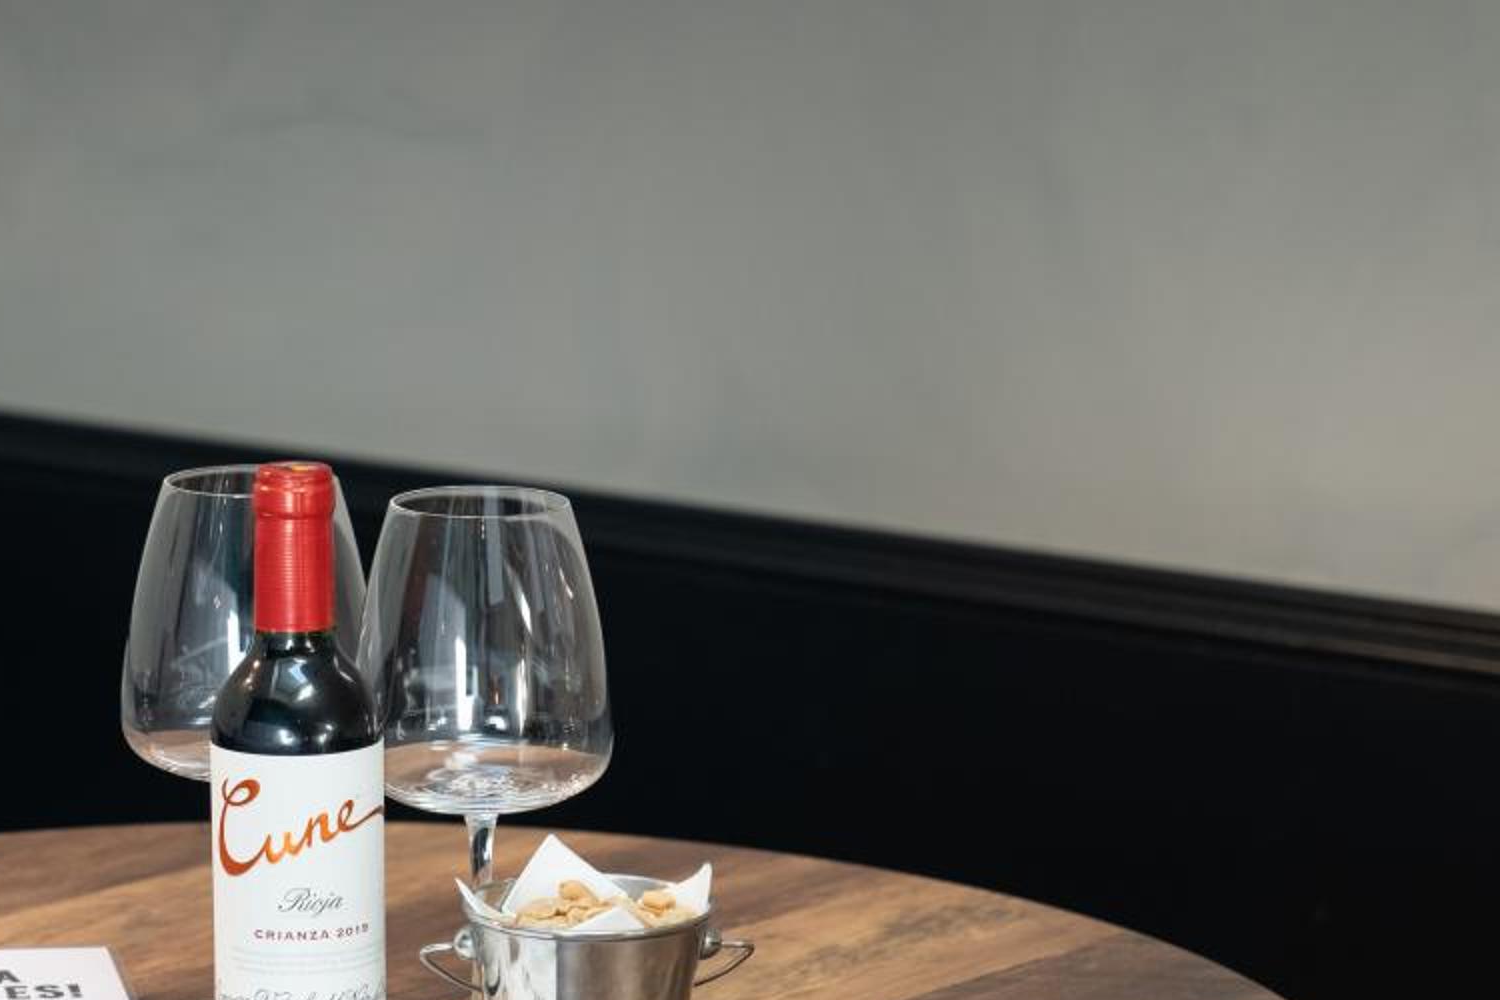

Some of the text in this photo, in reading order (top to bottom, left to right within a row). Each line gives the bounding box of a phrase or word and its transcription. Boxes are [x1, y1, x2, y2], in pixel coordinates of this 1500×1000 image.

[218, 777, 384, 877] Cune
[277, 887, 343, 918] Rioja
[253, 929, 330, 941] CRIANZA
